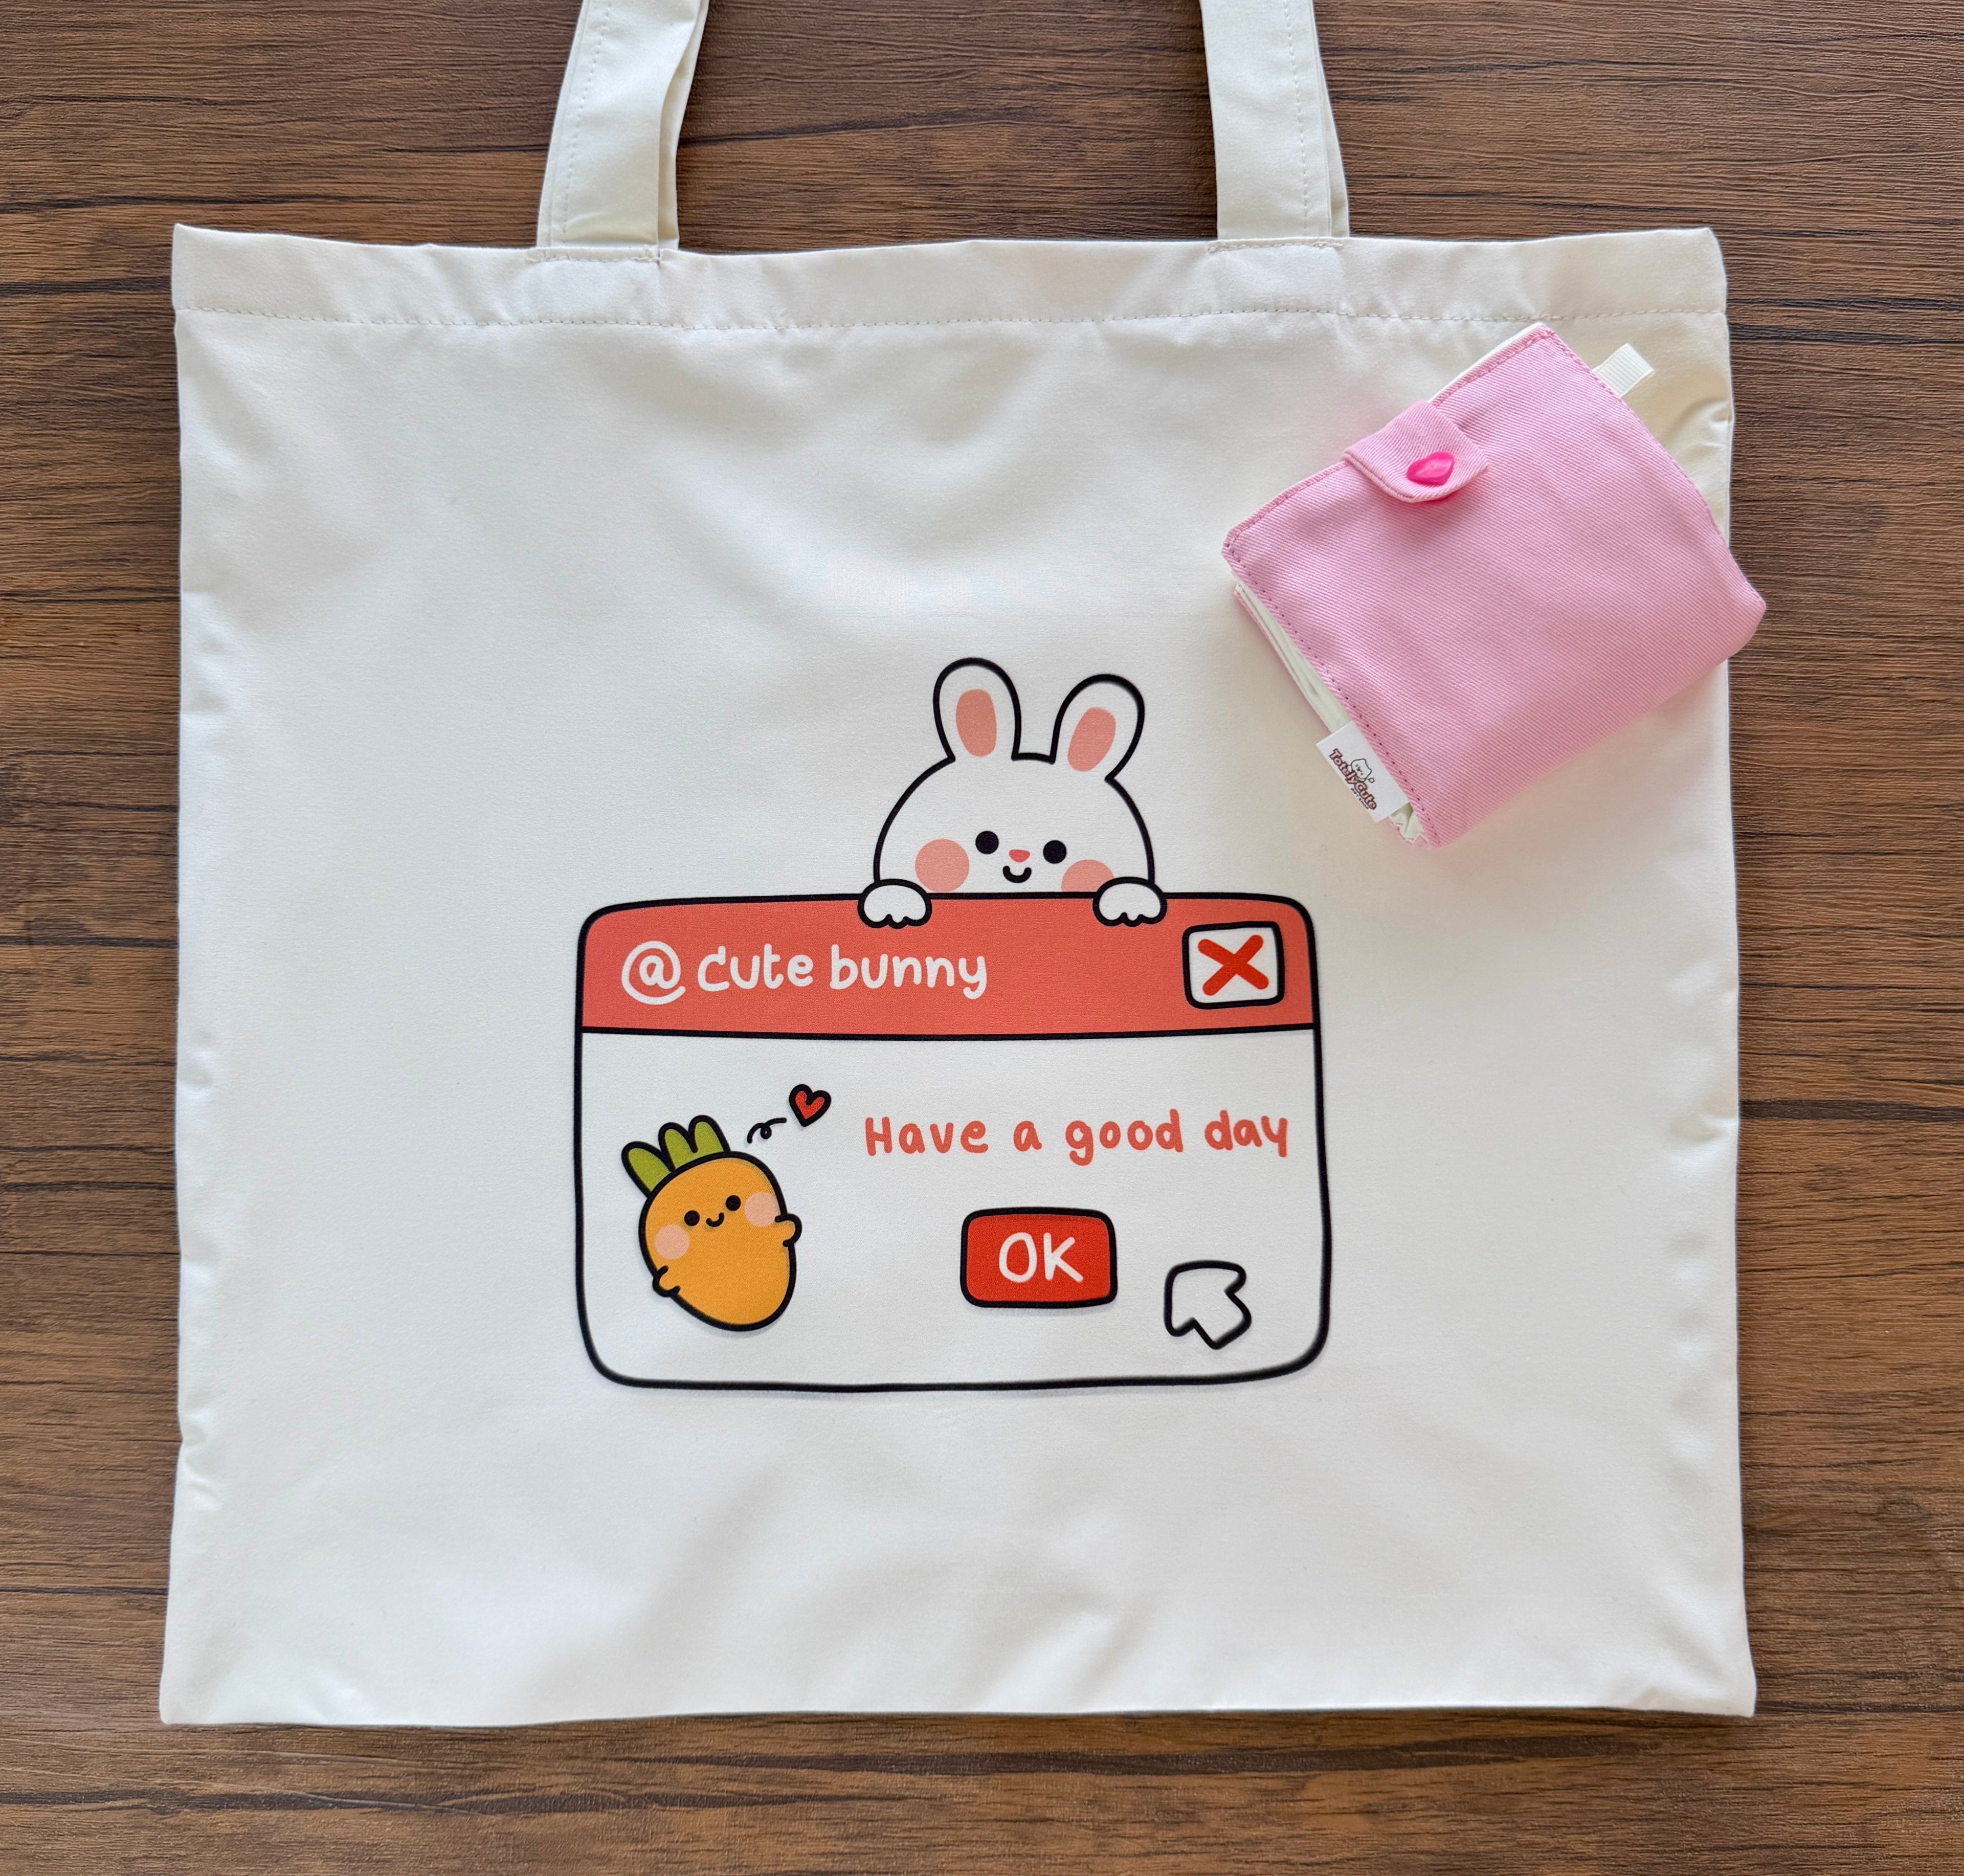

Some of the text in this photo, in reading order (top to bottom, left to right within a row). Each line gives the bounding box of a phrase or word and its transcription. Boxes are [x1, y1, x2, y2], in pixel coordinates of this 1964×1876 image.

[829, 943, 988, 1000] bunny
[864, 1108, 1288, 1167] Have a good day
[998, 1232, 1084, 1283] OK
